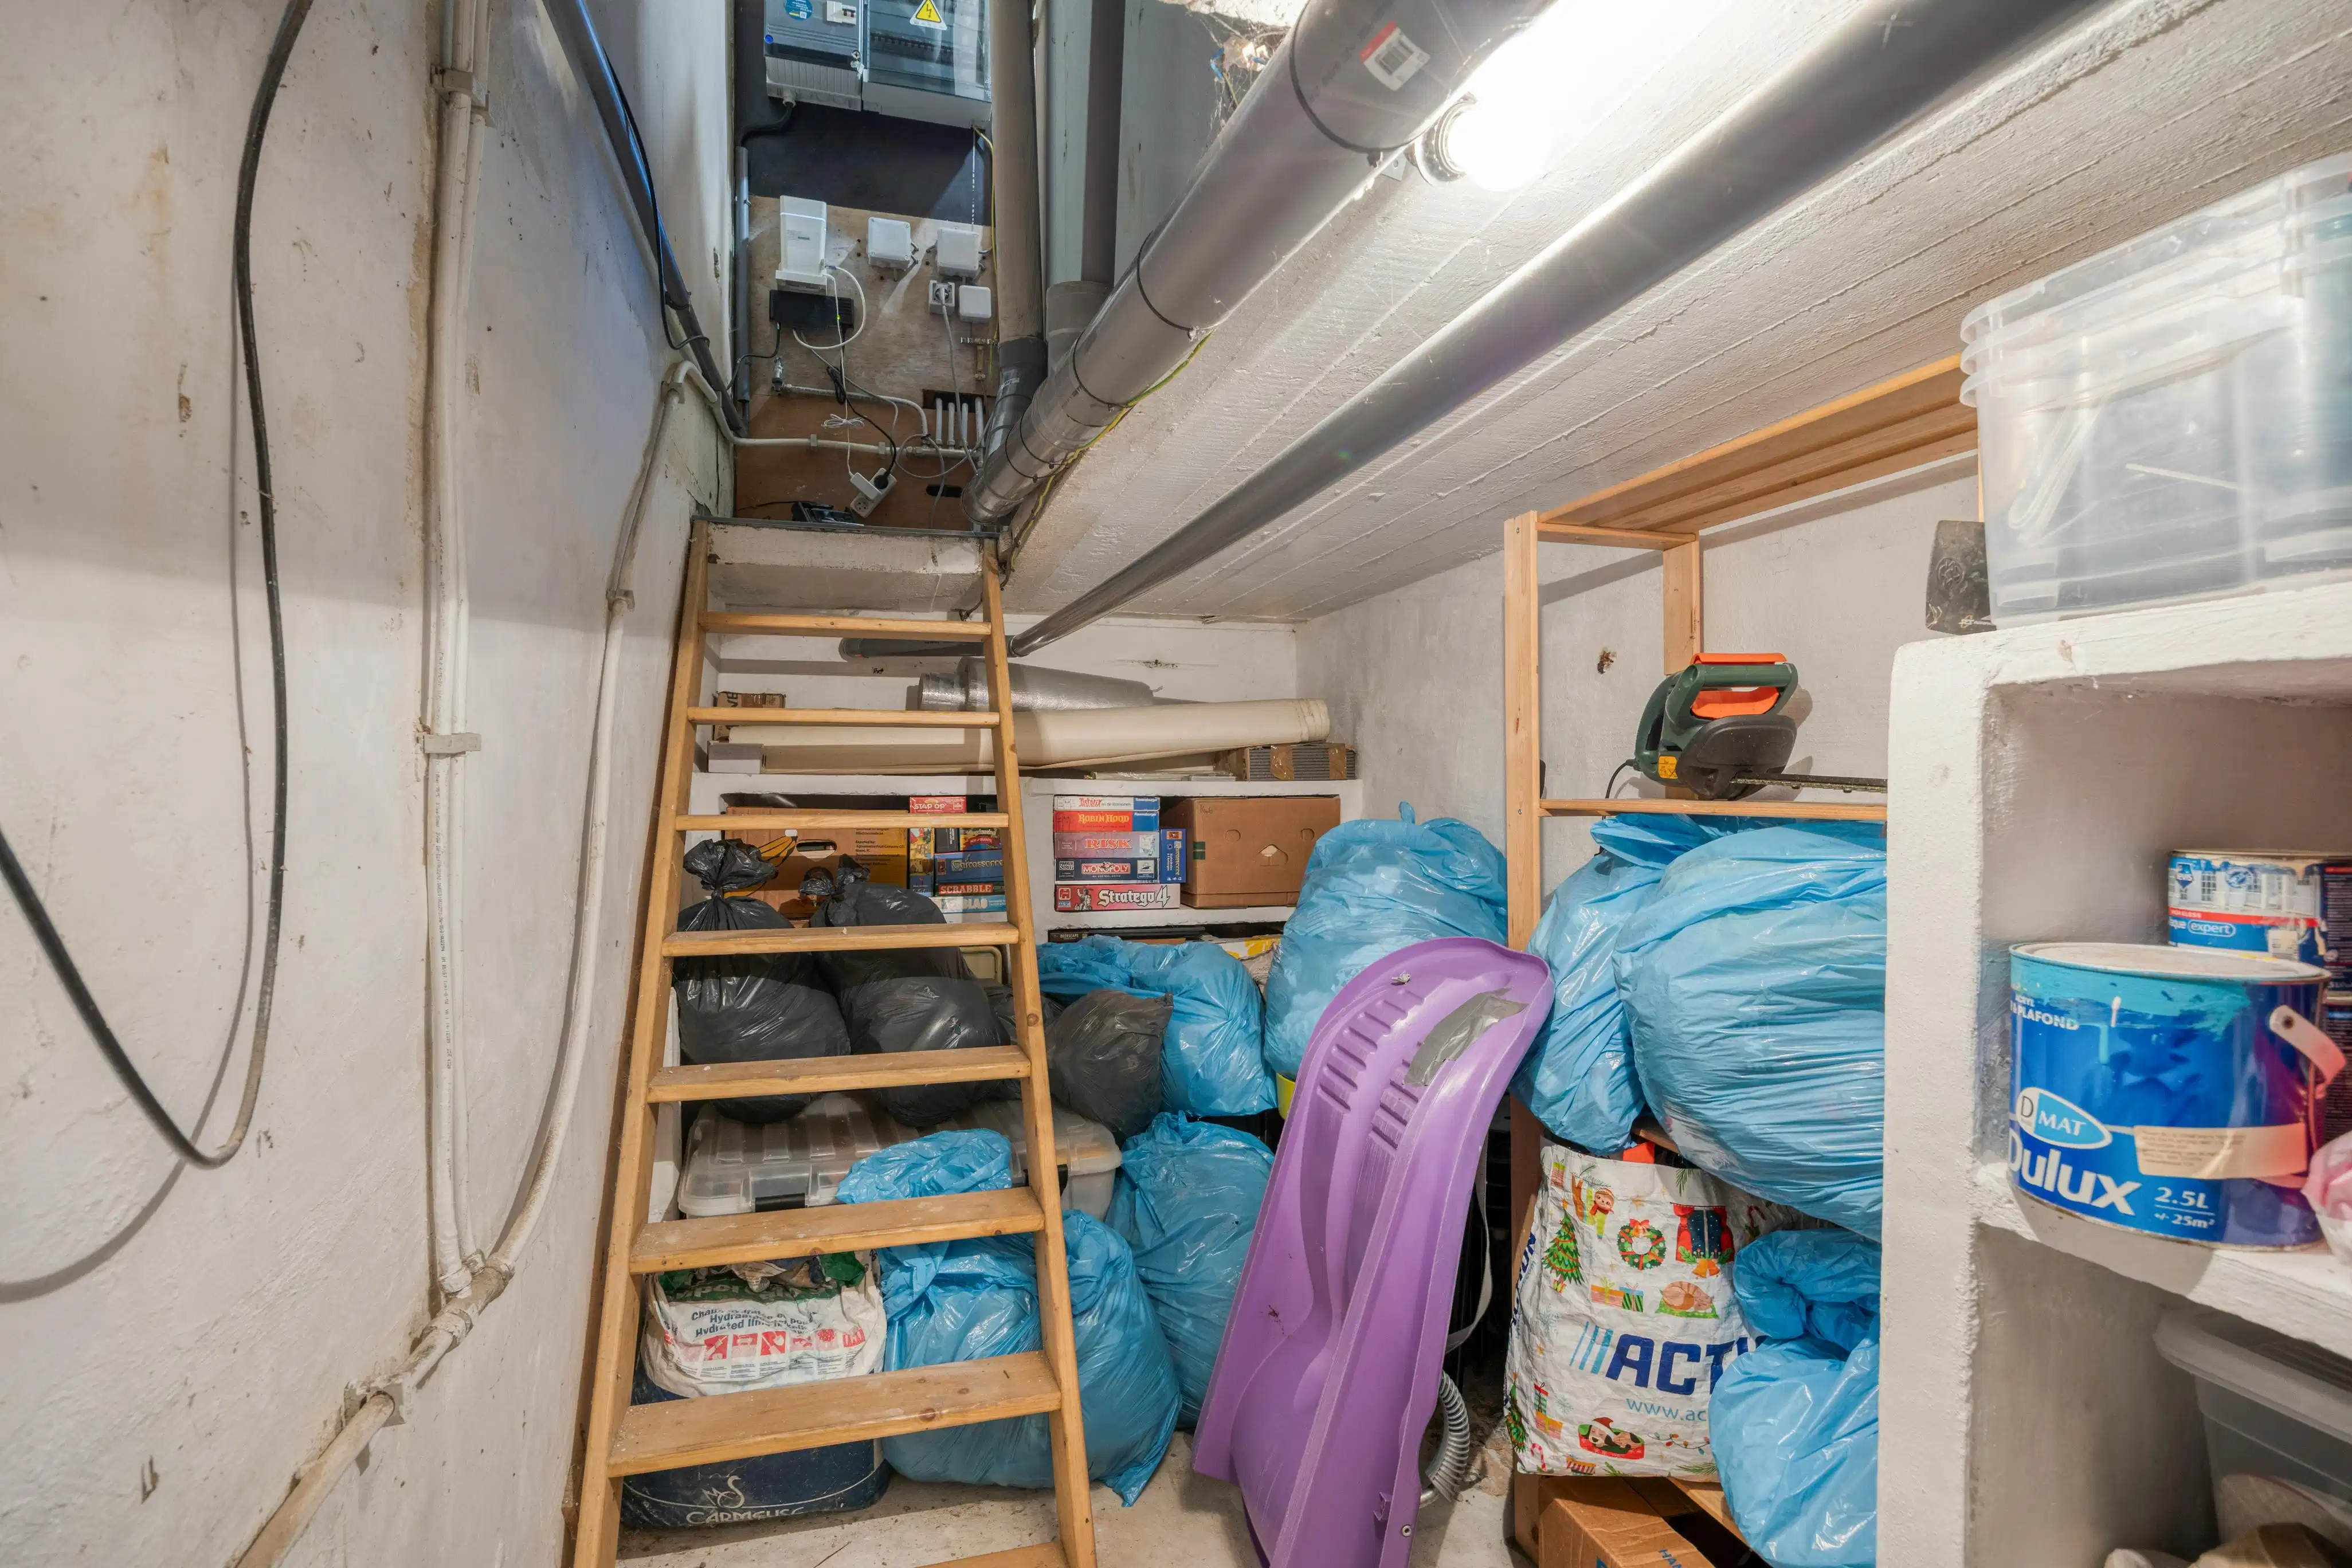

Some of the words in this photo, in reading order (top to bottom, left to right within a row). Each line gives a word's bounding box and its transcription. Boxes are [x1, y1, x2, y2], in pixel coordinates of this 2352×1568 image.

[1077, 813, 1106, 824] ROBIN
[1106, 813, 1130, 824] HOOD
[1085, 838, 1132, 849] RISK
[1083, 864, 1128, 873] MONOPOLY
[940, 884, 991, 894] SCRABBLE
[1097, 889, 1155, 907] Stratego
[1155, 885, 1170, 907] 4
[2190, 922, 2231, 935] expert
[2017, 1005, 2079, 1030] PLAFOND
[2021, 1095, 2034, 1118] D
[2038, 1111, 2087, 1136] MAT
[2008, 1127, 2142, 1216] Dulux
[2155, 1186, 2210, 1209] 2.5L
[1605, 1333, 1769, 1395] ACT
[1626, 1398, 1707, 1422] www.ac
